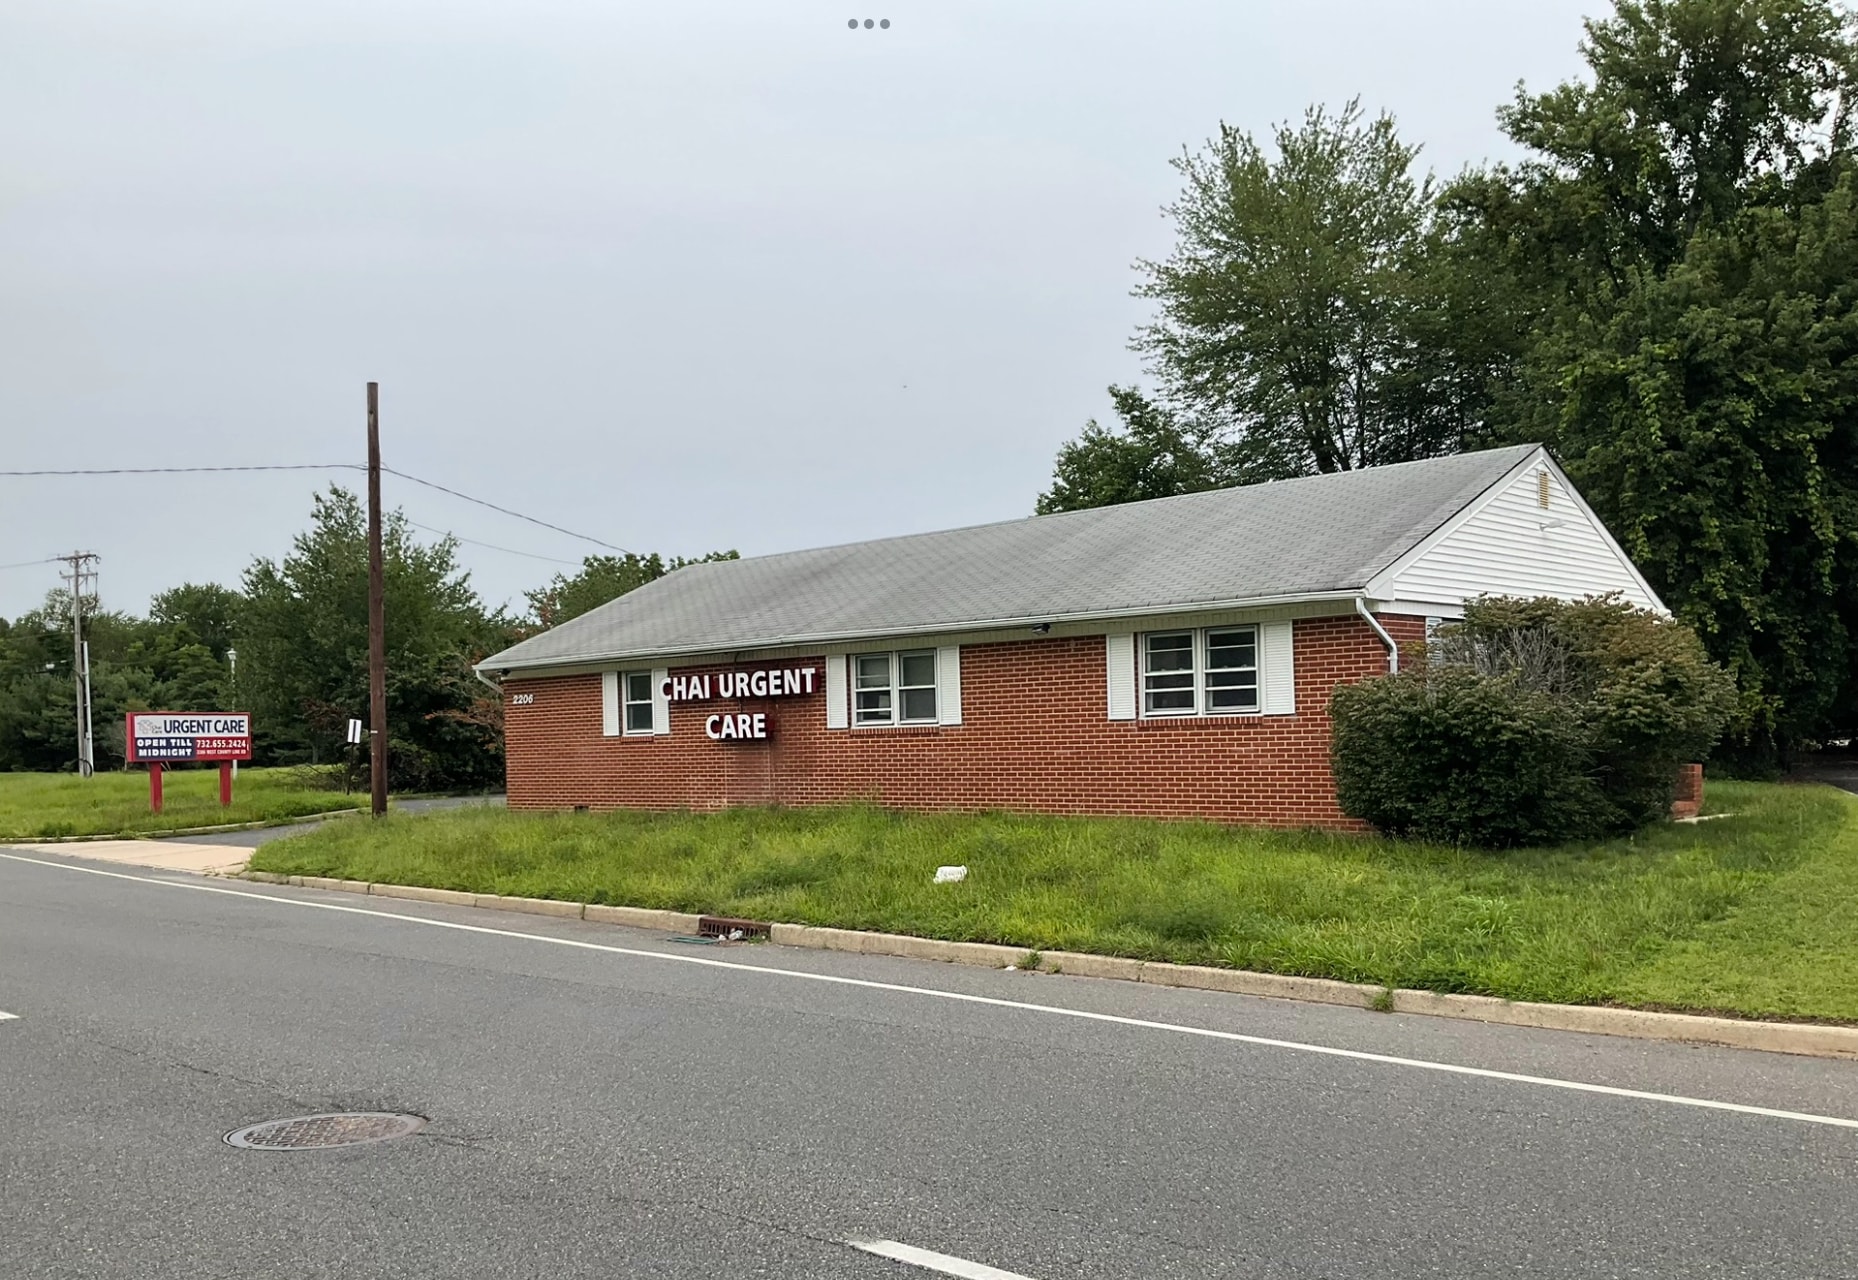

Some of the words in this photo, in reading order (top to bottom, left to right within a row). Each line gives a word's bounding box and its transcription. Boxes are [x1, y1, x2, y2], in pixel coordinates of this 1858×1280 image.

[658, 674, 711, 701] CHAI
[718, 667, 816, 699] URGENT
[512, 694, 534, 705] 2206
[164, 719, 212, 734] URGENT
[214, 719, 245, 734] CARE
[705, 713, 767, 740] CARE
[137, 738, 167, 747] OPEN
[170, 738, 192, 747] TILL
[196, 739, 247, 748] 732.655.2424
[138, 748, 192, 757] MIDNIGHT
